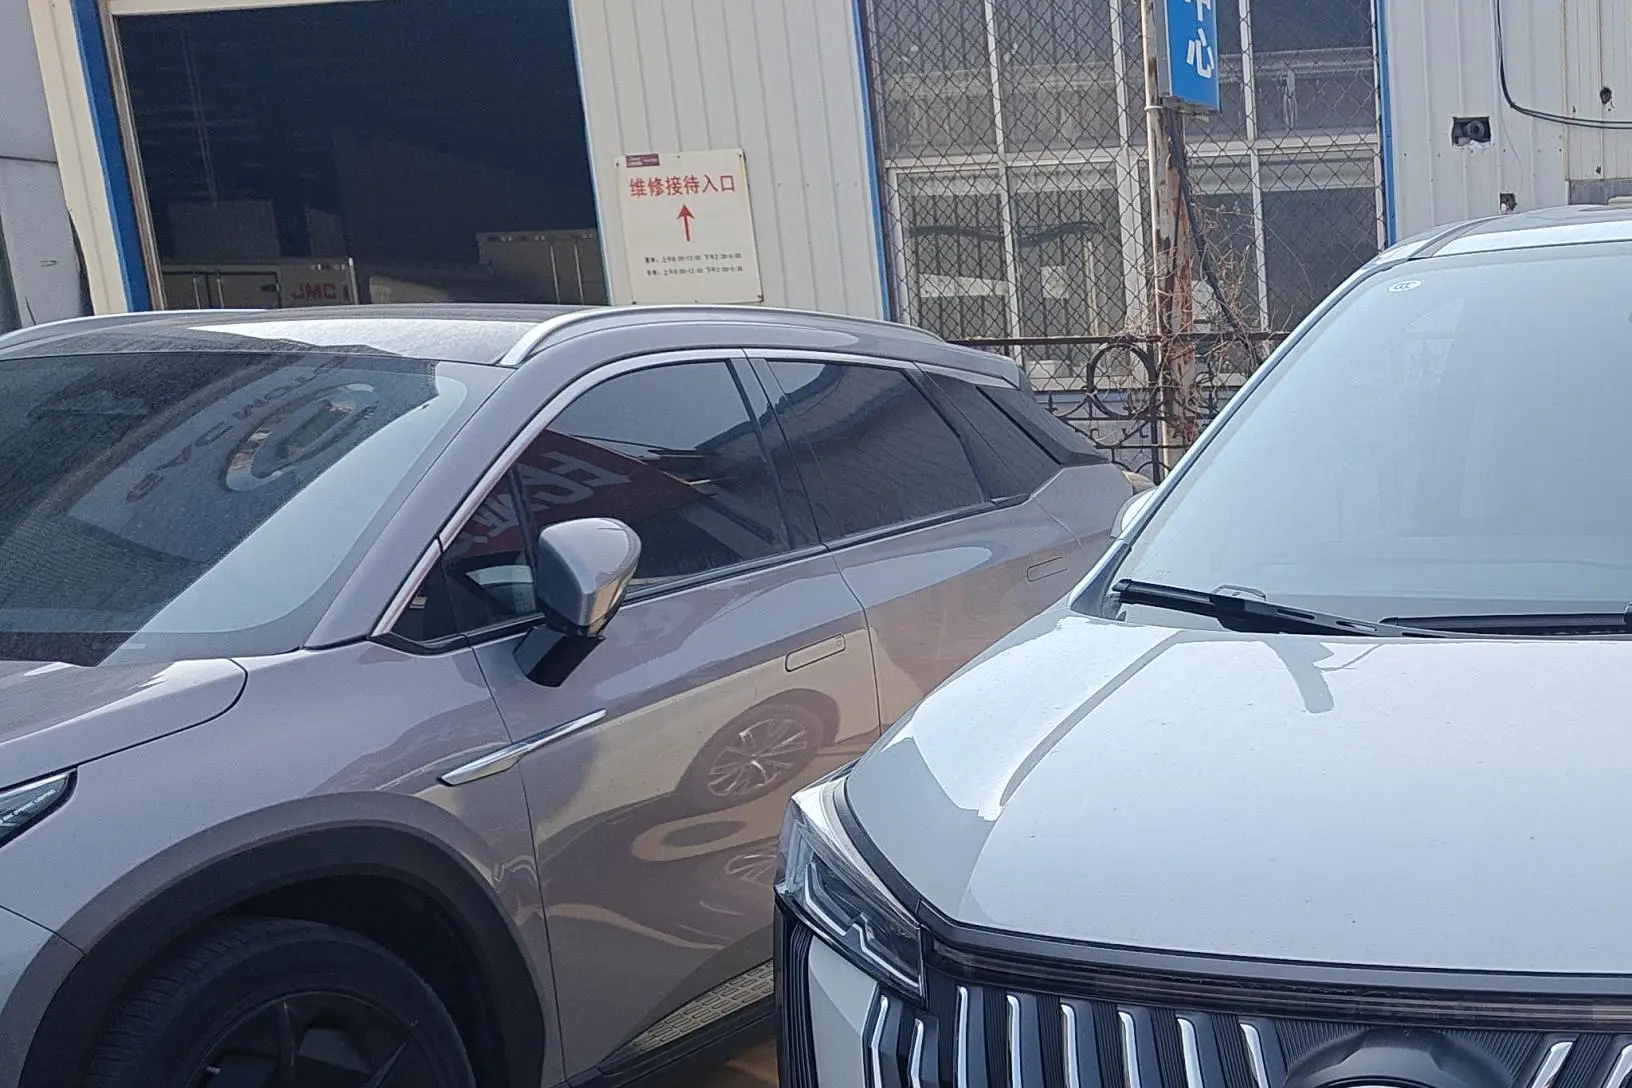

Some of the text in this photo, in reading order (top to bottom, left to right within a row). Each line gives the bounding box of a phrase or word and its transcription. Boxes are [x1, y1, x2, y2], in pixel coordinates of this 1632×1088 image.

[629, 173, 735, 198] 维修接待入口
[293, 283, 337, 300] JMC
